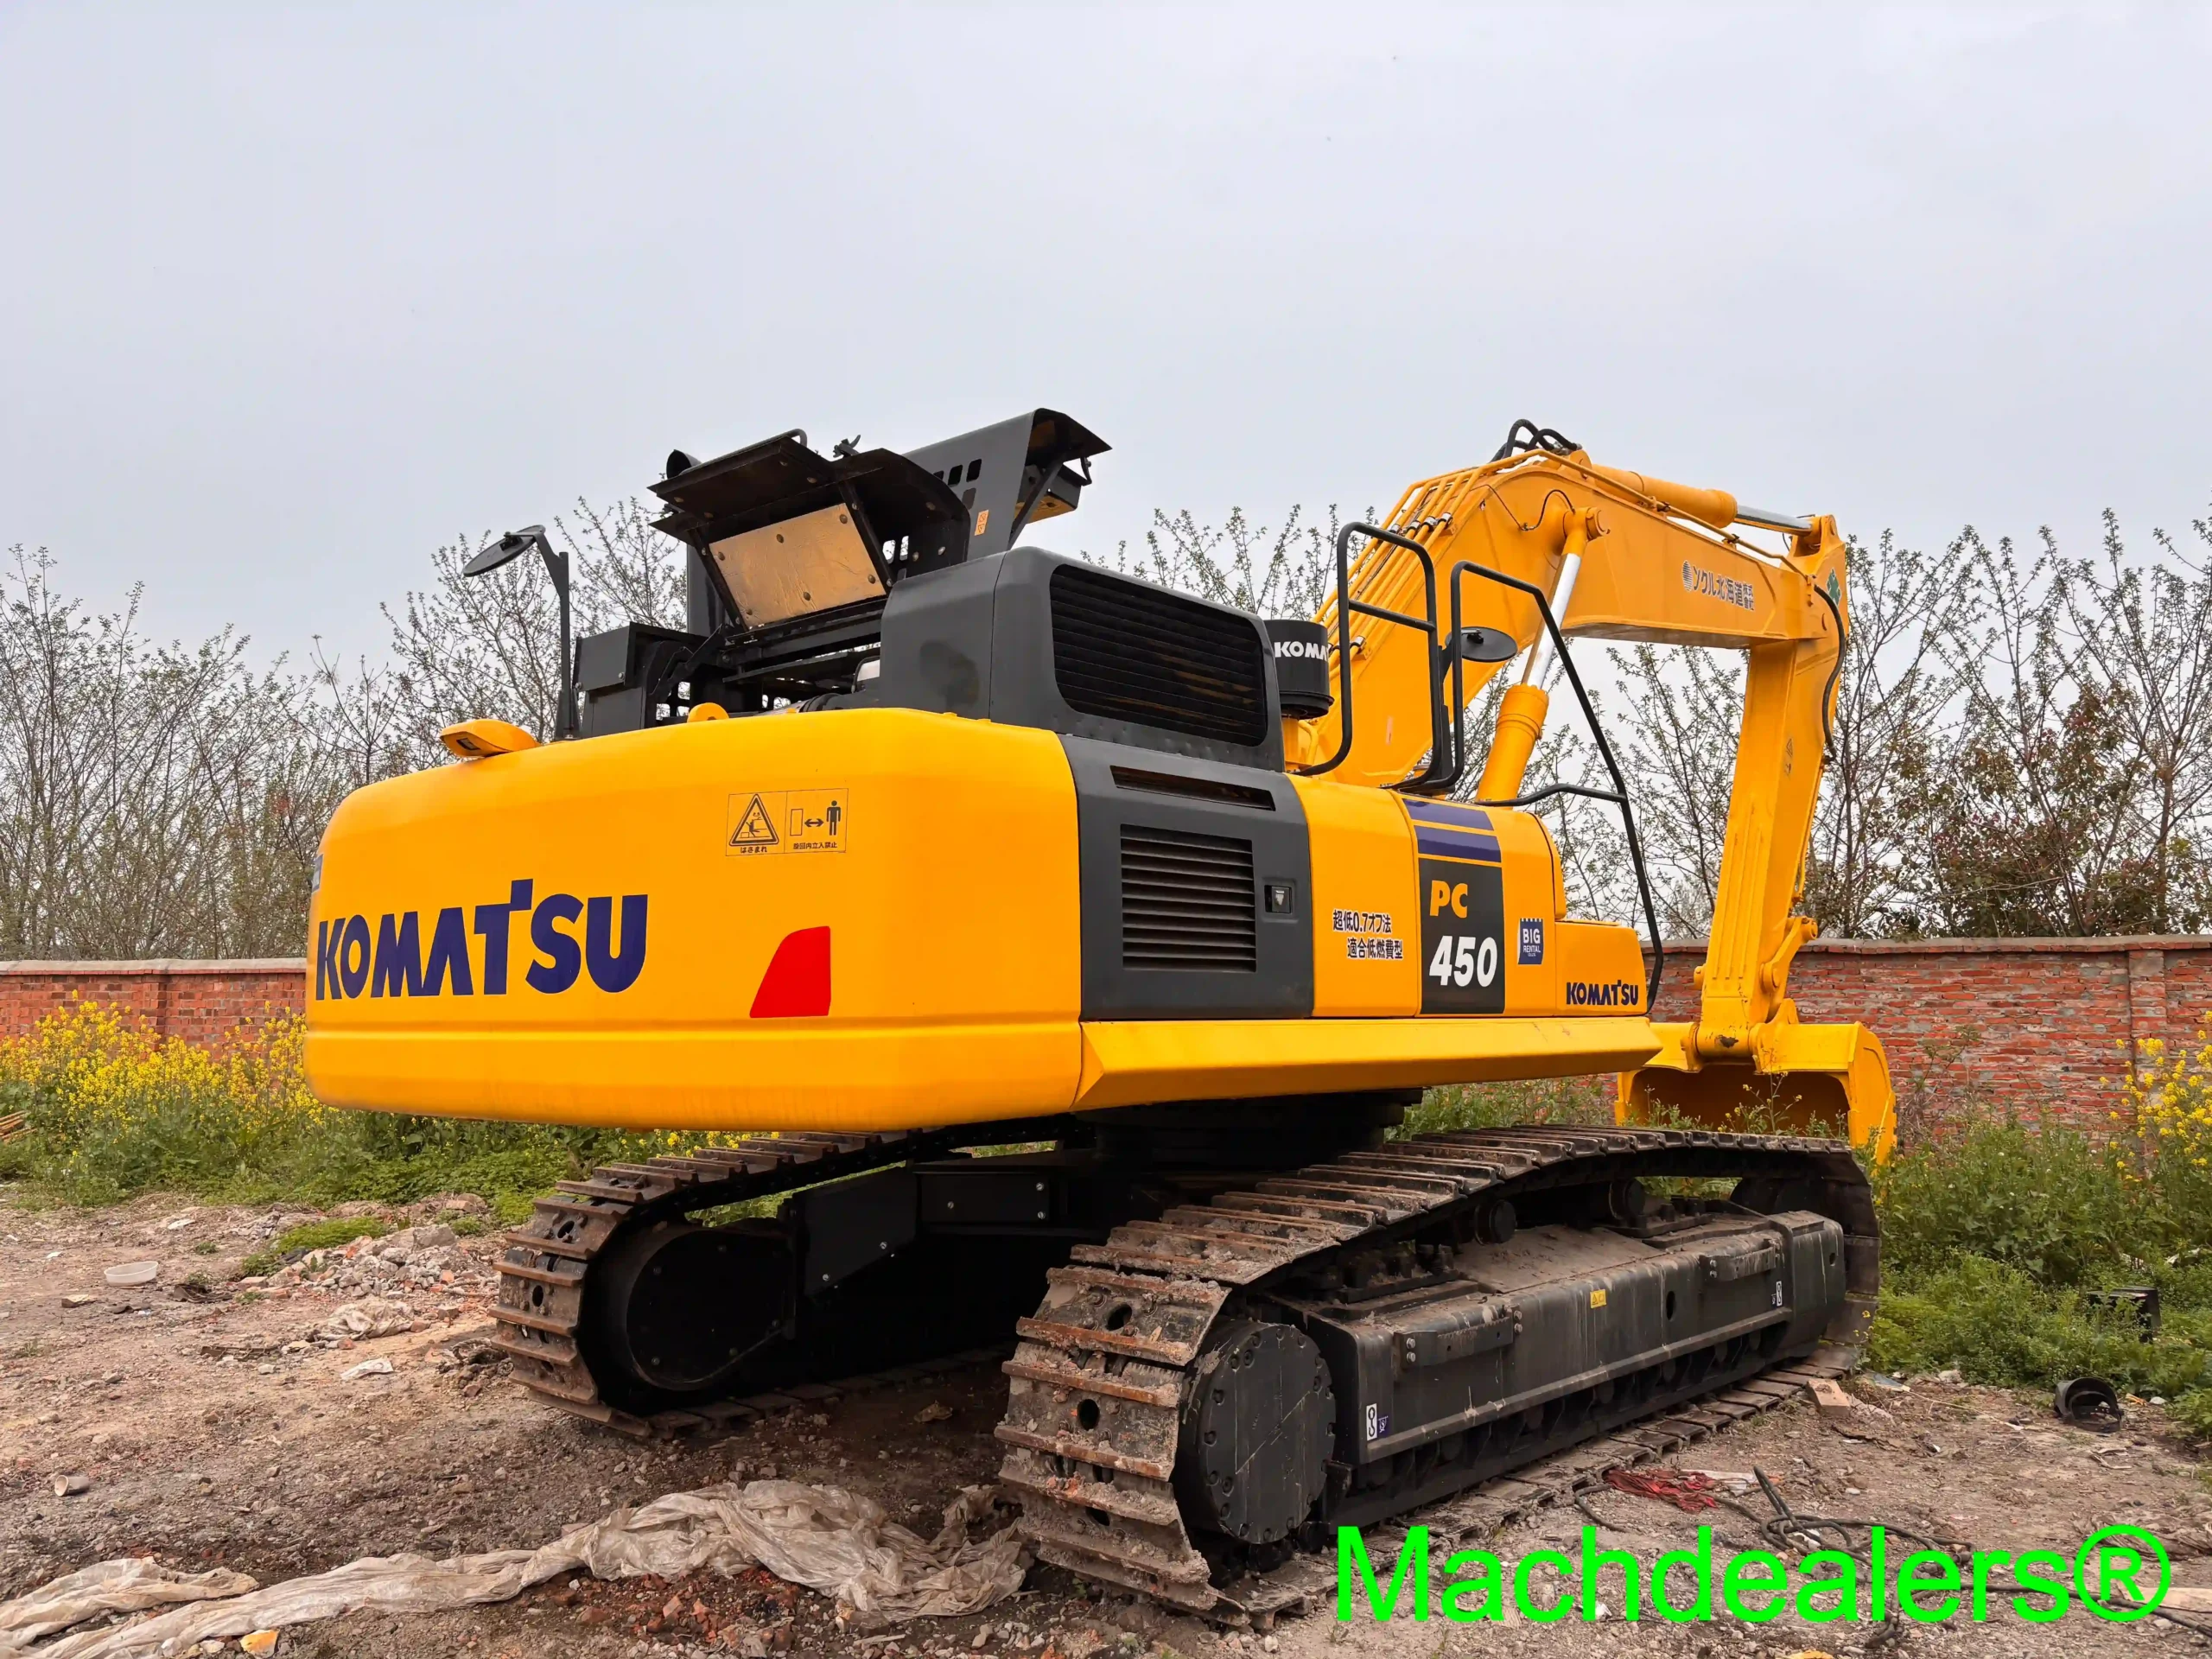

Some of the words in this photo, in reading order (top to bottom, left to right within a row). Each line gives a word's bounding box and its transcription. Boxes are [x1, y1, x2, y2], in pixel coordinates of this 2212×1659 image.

[1429, 880, 1468, 918] PC
[315, 878, 649, 1001] KOMATSU
[1522, 928, 1541, 944] BIG
[1522, 944, 1541, 953] RENTAL
[1428, 935, 1497, 988] 450
[1566, 979, 1638, 1006] KOMATSU
